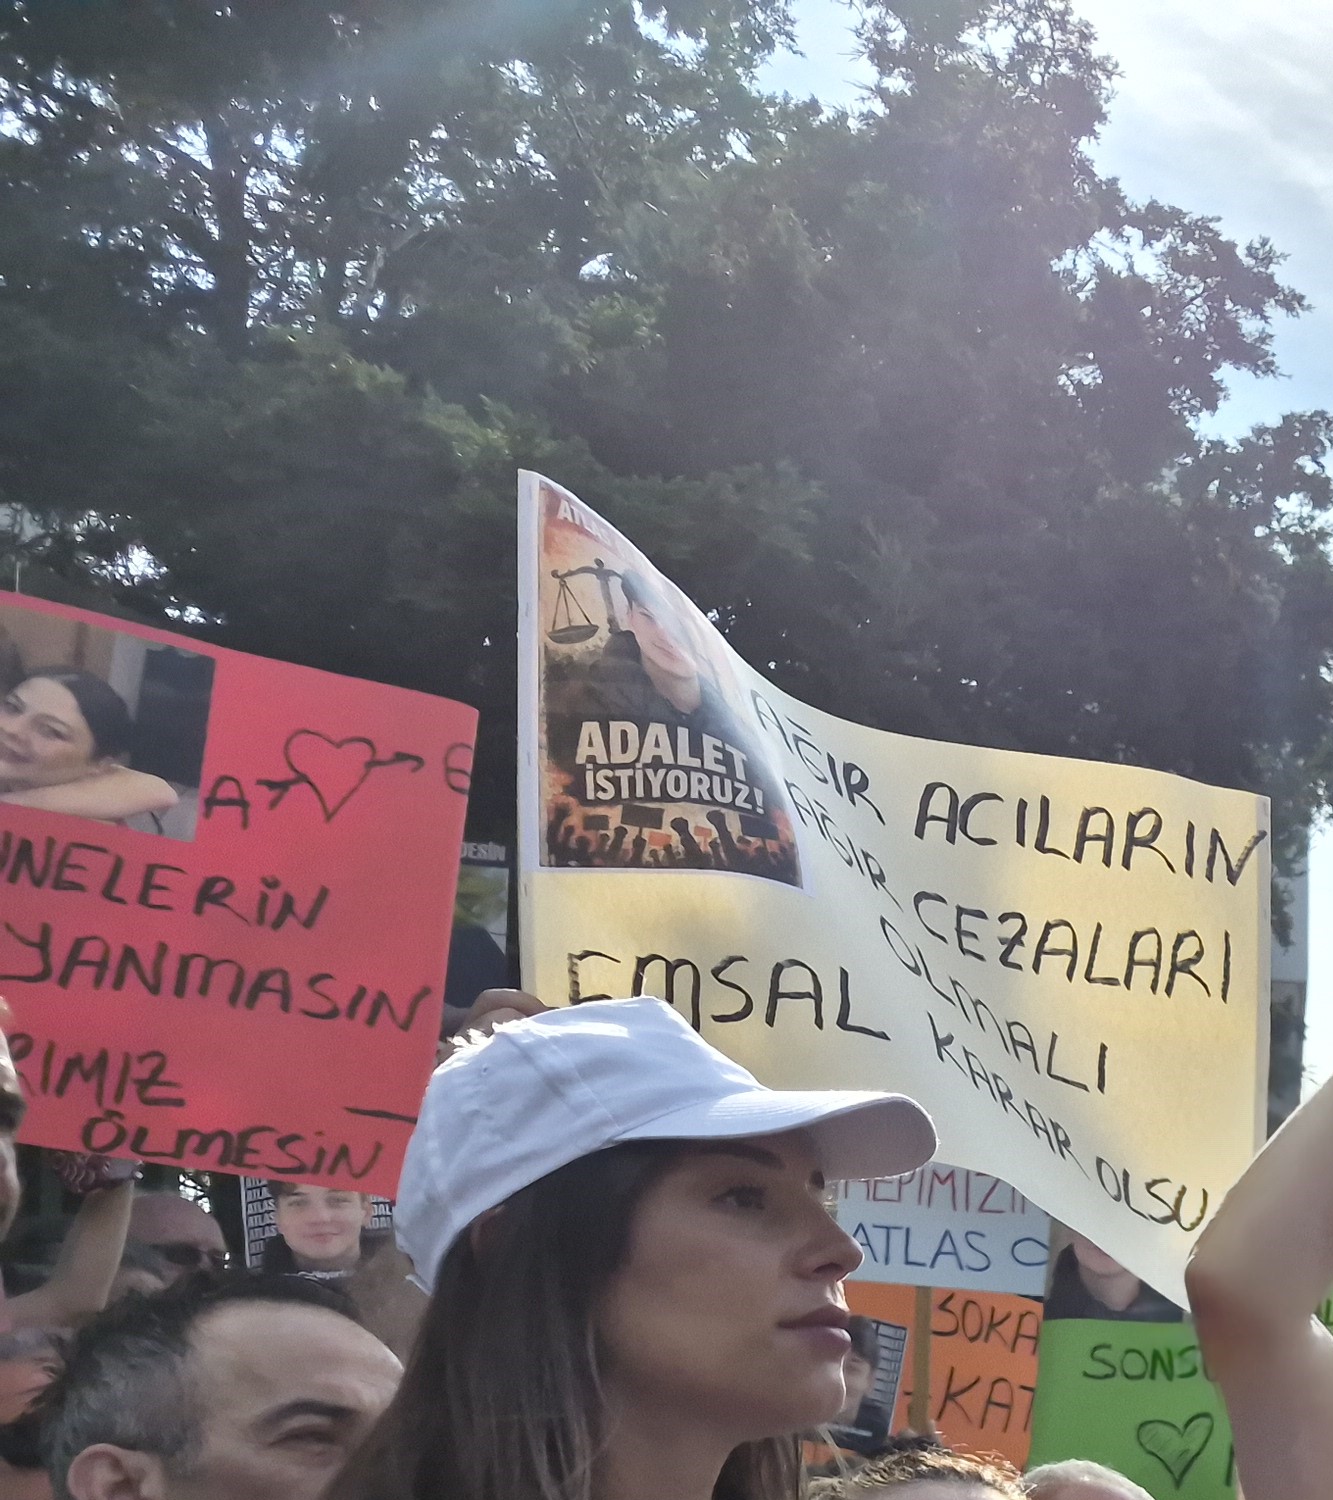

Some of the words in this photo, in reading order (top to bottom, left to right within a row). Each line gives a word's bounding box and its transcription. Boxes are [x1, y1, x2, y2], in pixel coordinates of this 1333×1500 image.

[575, 721, 748, 782] ADALET
[585, 763, 765, 814] İSTİYORUZ!
[751, 689, 886, 826] AĞIR
[913, 781, 1268, 887] ACILARIN
[0, 831, 330, 931] NELERİN
[0, 921, 432, 1032] YANMASIN
[913, 890, 1231, 1004] CEZALARI
[880, 915, 1109, 1095] OLMALI
[8, 1031, 187, 1107] RIMIZ
[81, 1109, 384, 1180] ÖLMESİN
[926, 1010, 1091, 1182] KARAR
[1095, 1155, 1209, 1233] OLSU
[850, 1222, 992, 1273] ATLAS
